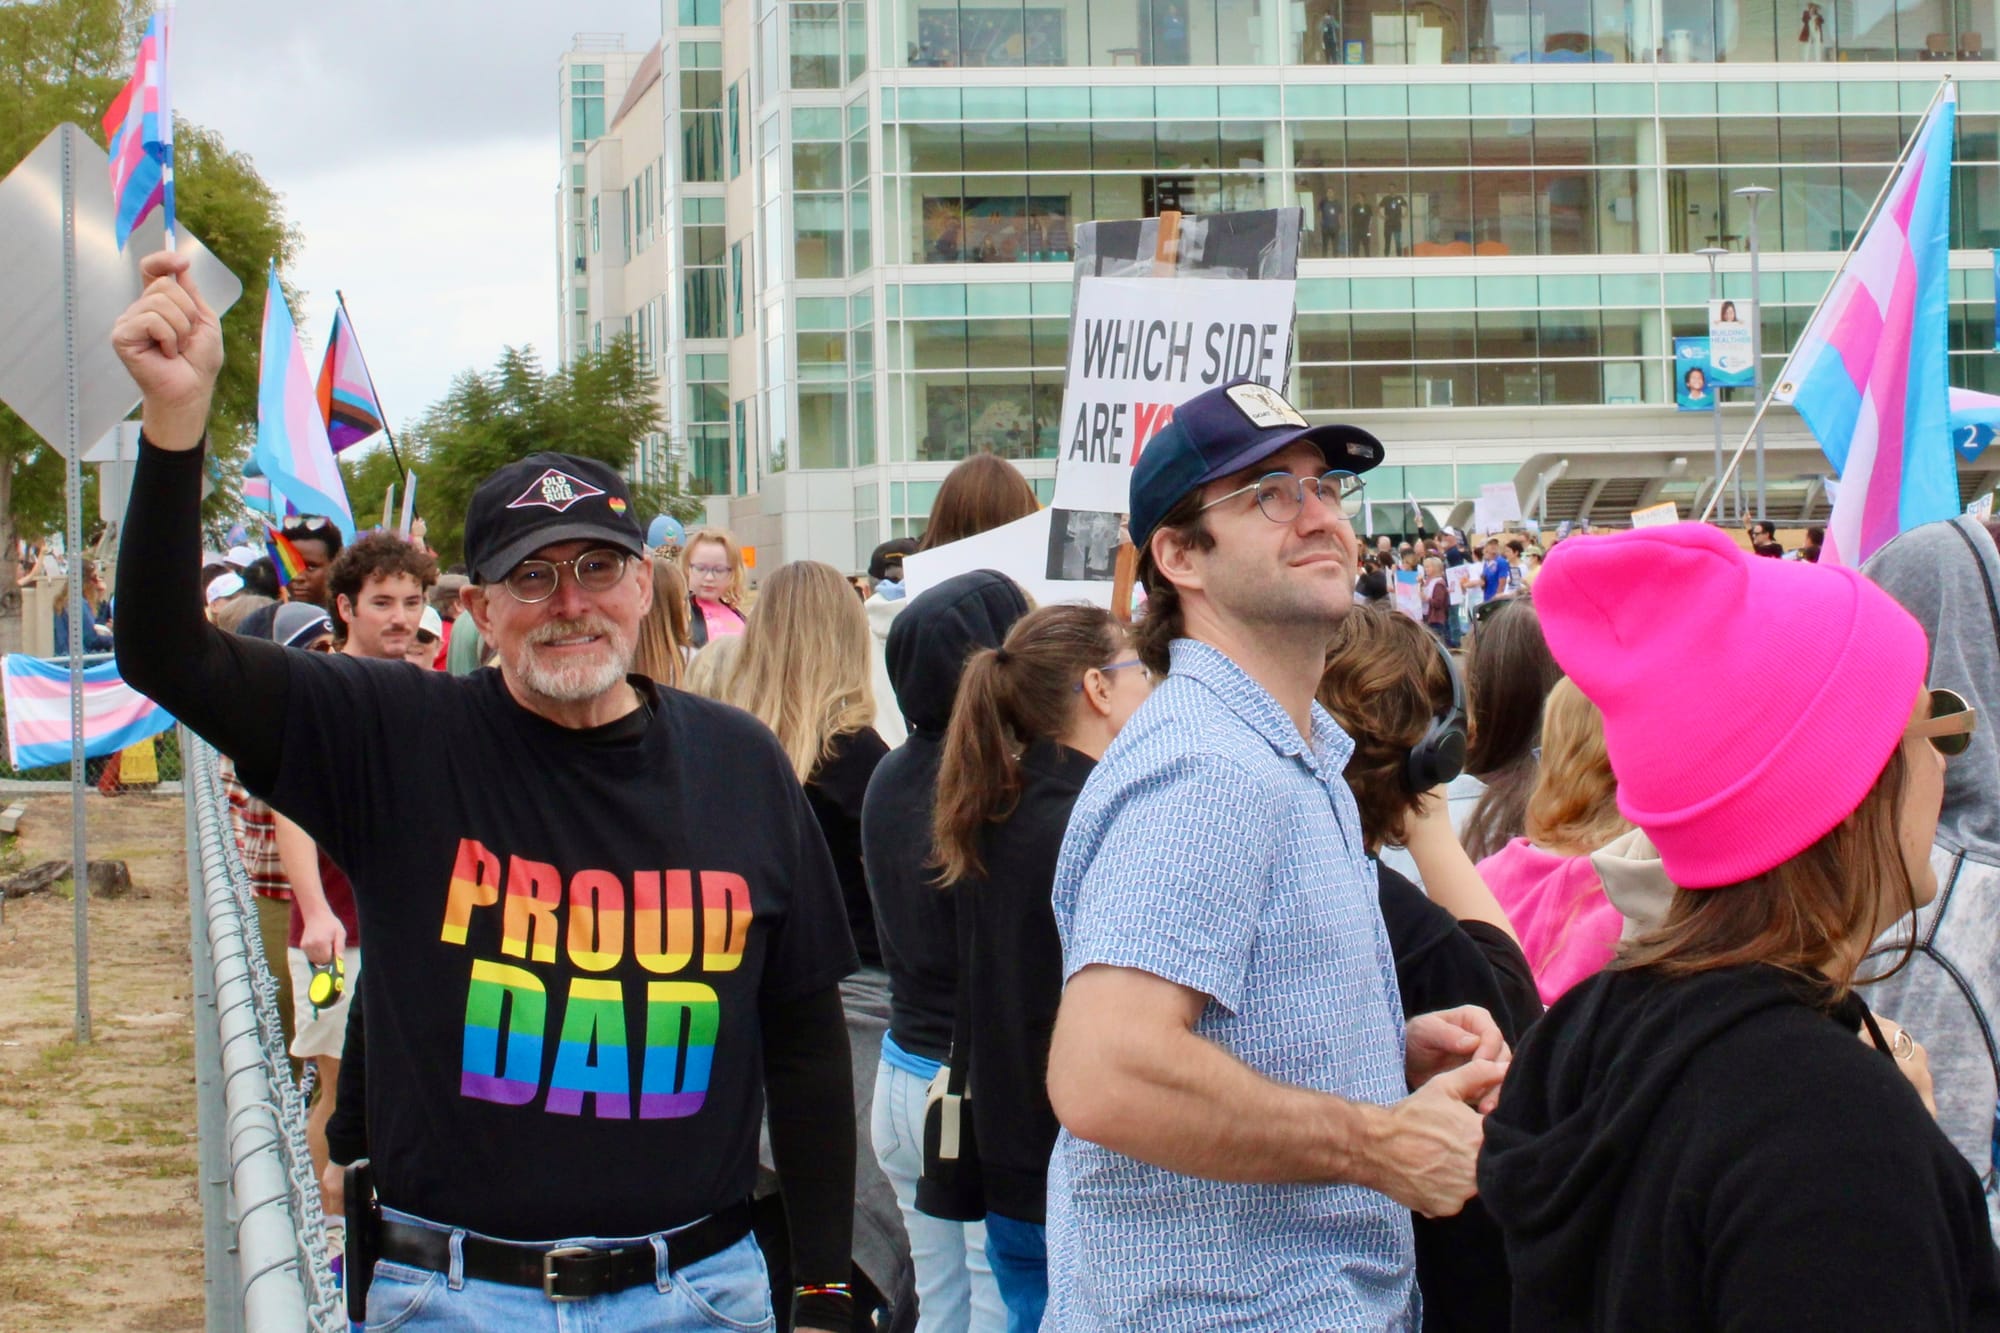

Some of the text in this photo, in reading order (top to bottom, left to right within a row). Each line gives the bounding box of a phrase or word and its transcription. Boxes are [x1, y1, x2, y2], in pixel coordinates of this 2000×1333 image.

[1084, 319, 1278, 385] WHICH SIDE
[1068, 402, 1127, 464] ARE
[1963, 425, 1978, 447] 2
[541, 484, 571, 494] GUYS
[543, 476, 566, 486] OLD
[544, 490, 574, 503] RULE
[441, 838, 753, 973] PROUD
[460, 959, 719, 1119] DAD
